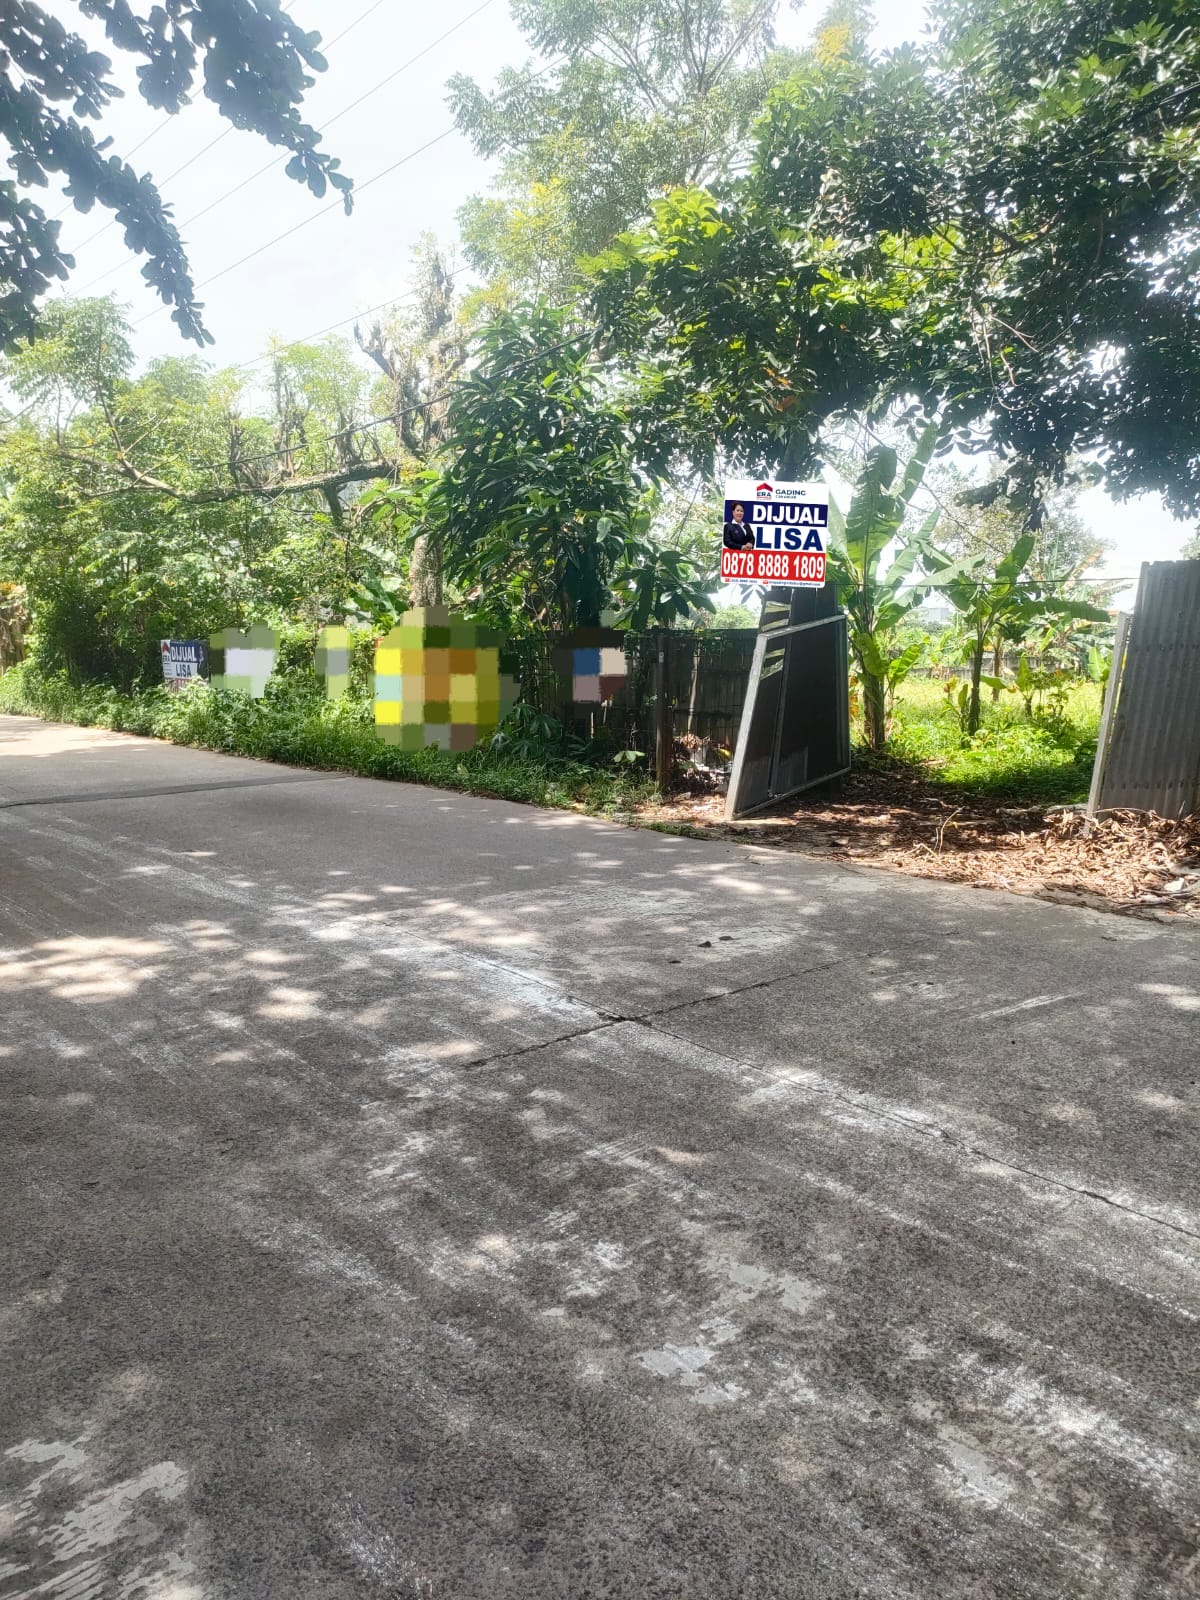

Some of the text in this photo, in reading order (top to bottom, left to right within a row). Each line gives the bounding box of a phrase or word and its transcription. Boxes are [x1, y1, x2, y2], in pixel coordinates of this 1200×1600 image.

[752, 504, 825, 525] DIJUAL
[756, 527, 824, 551] LISA
[723, 552, 825, 579] 0878 8888 1809
[171, 646, 197, 662] DIJUAL
[175, 663, 192, 677] LISA
